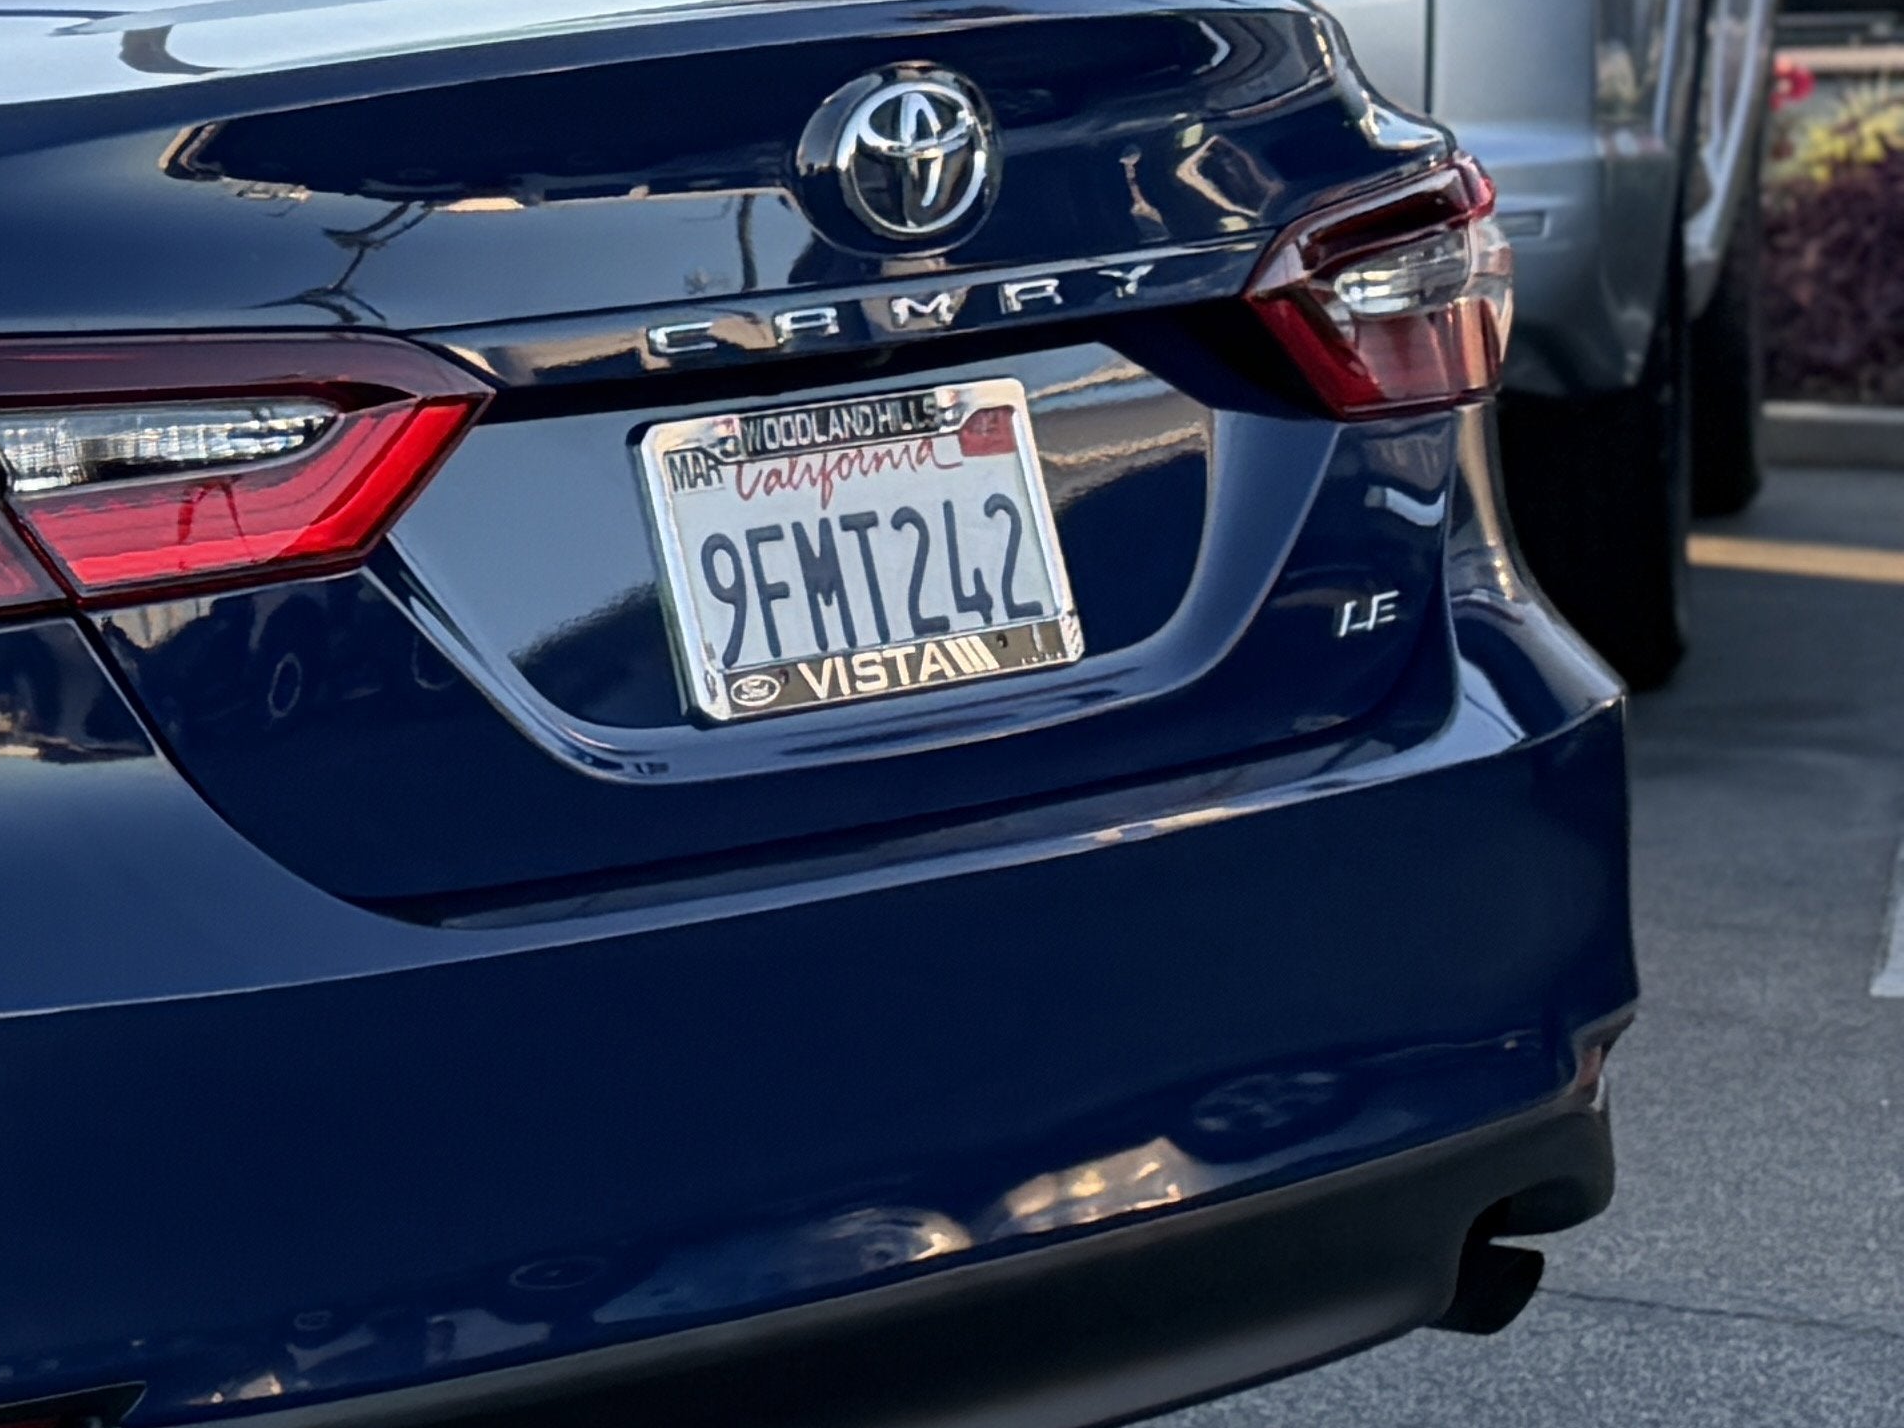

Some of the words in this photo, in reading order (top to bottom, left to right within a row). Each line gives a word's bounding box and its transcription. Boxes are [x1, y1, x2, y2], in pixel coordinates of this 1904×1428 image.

[647, 264, 1155, 355] CAMRY
[744, 404, 875, 453] WOODLAND
[876, 395, 939, 435] HILLS
[666, 450, 725, 493] MAR
[735, 435, 963, 510] California
[699, 493, 1044, 669] 9FMT242
[1338, 589, 1399, 638] LE
[797, 640, 958, 701] VISTA
